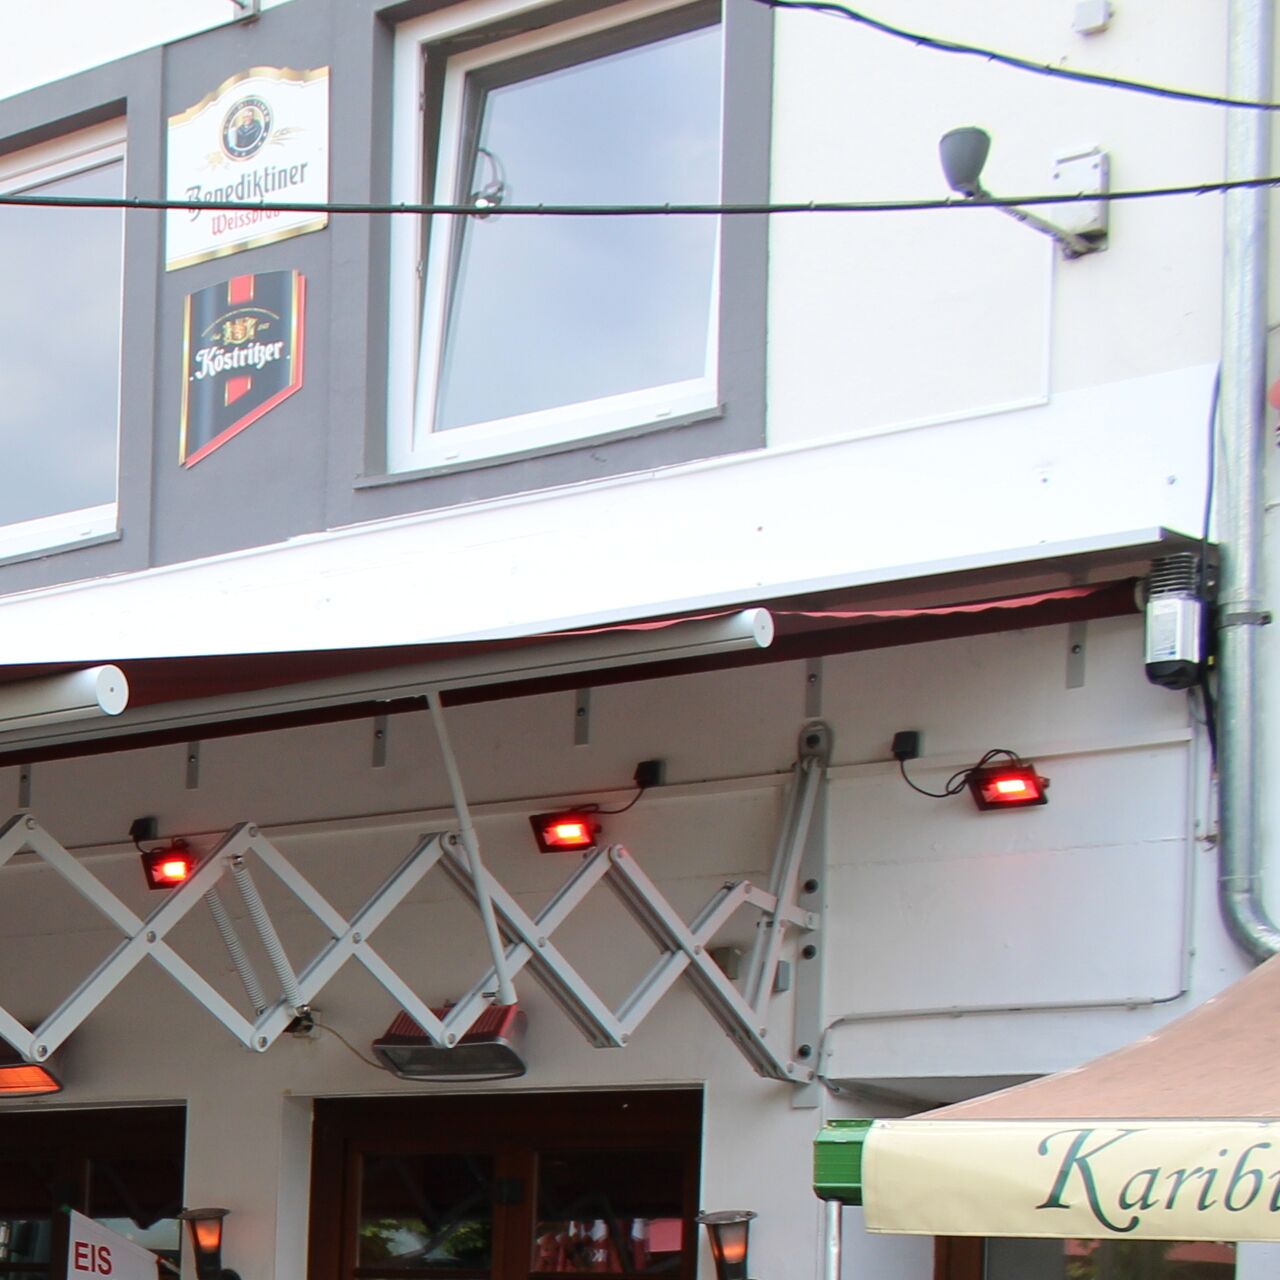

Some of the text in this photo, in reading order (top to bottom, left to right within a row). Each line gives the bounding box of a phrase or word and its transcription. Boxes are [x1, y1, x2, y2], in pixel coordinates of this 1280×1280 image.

[185, 162, 308, 222] Benediktiner
[195, 341, 284, 379] Köstritzer
[74, 1241, 113, 1275] EIS
